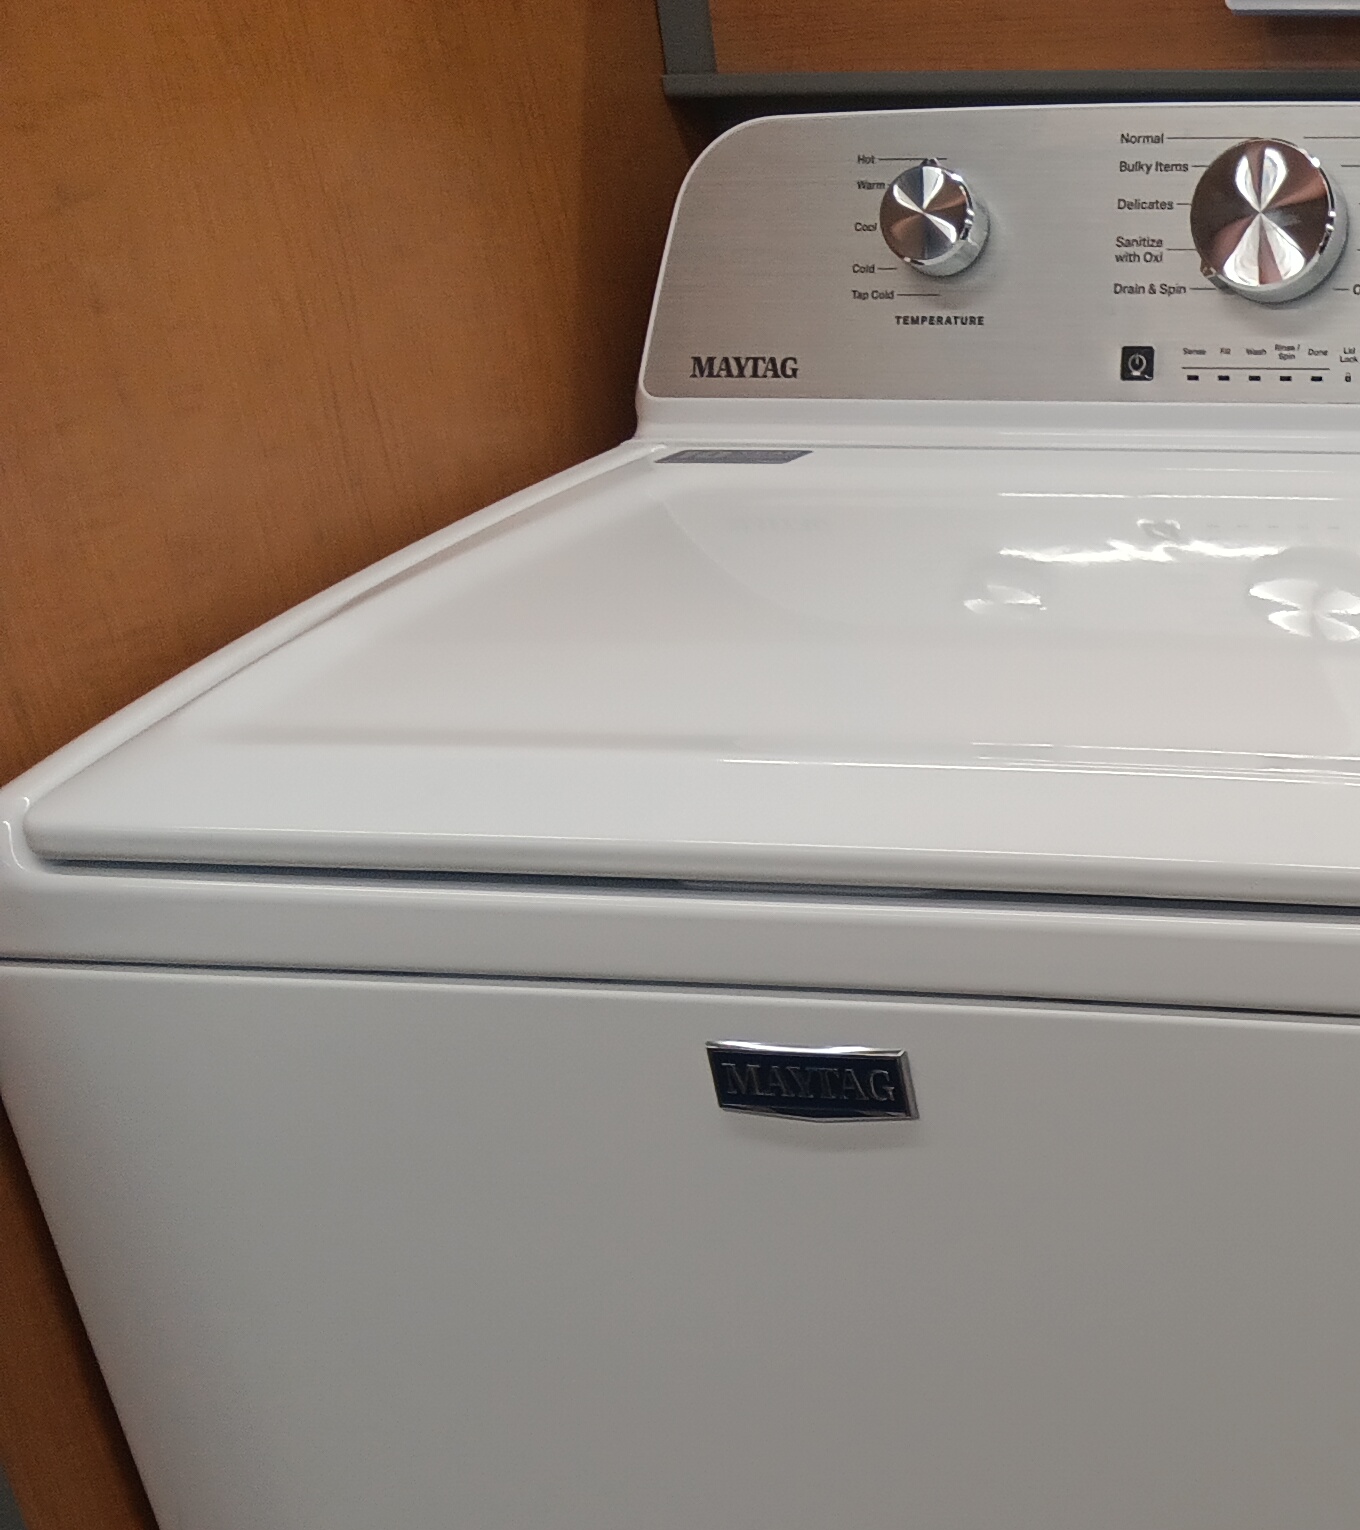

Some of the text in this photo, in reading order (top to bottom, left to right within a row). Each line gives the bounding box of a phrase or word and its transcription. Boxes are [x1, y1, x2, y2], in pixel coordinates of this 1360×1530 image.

[1120, 133, 1165, 144] Normal
[857, 154, 876, 165] Hot
[1119, 160, 1189, 174] Bulky Items
[857, 180, 886, 190] Warm
[1117, 199, 1174, 210] Delicates
[854, 222, 877, 232] Cool
[1115, 236, 1163, 248] Sanitize
[1115, 252, 1163, 263] with Oxi
[852, 264, 875, 274] Cold
[851, 289, 895, 301] Tap Cold
[1113, 283, 1187, 297] Drain & Spin
[895, 315, 985, 326] TEMPERATURE
[689, 356, 799, 379] MAYTAG
[721, 1062, 895, 1101] MAYTAG
